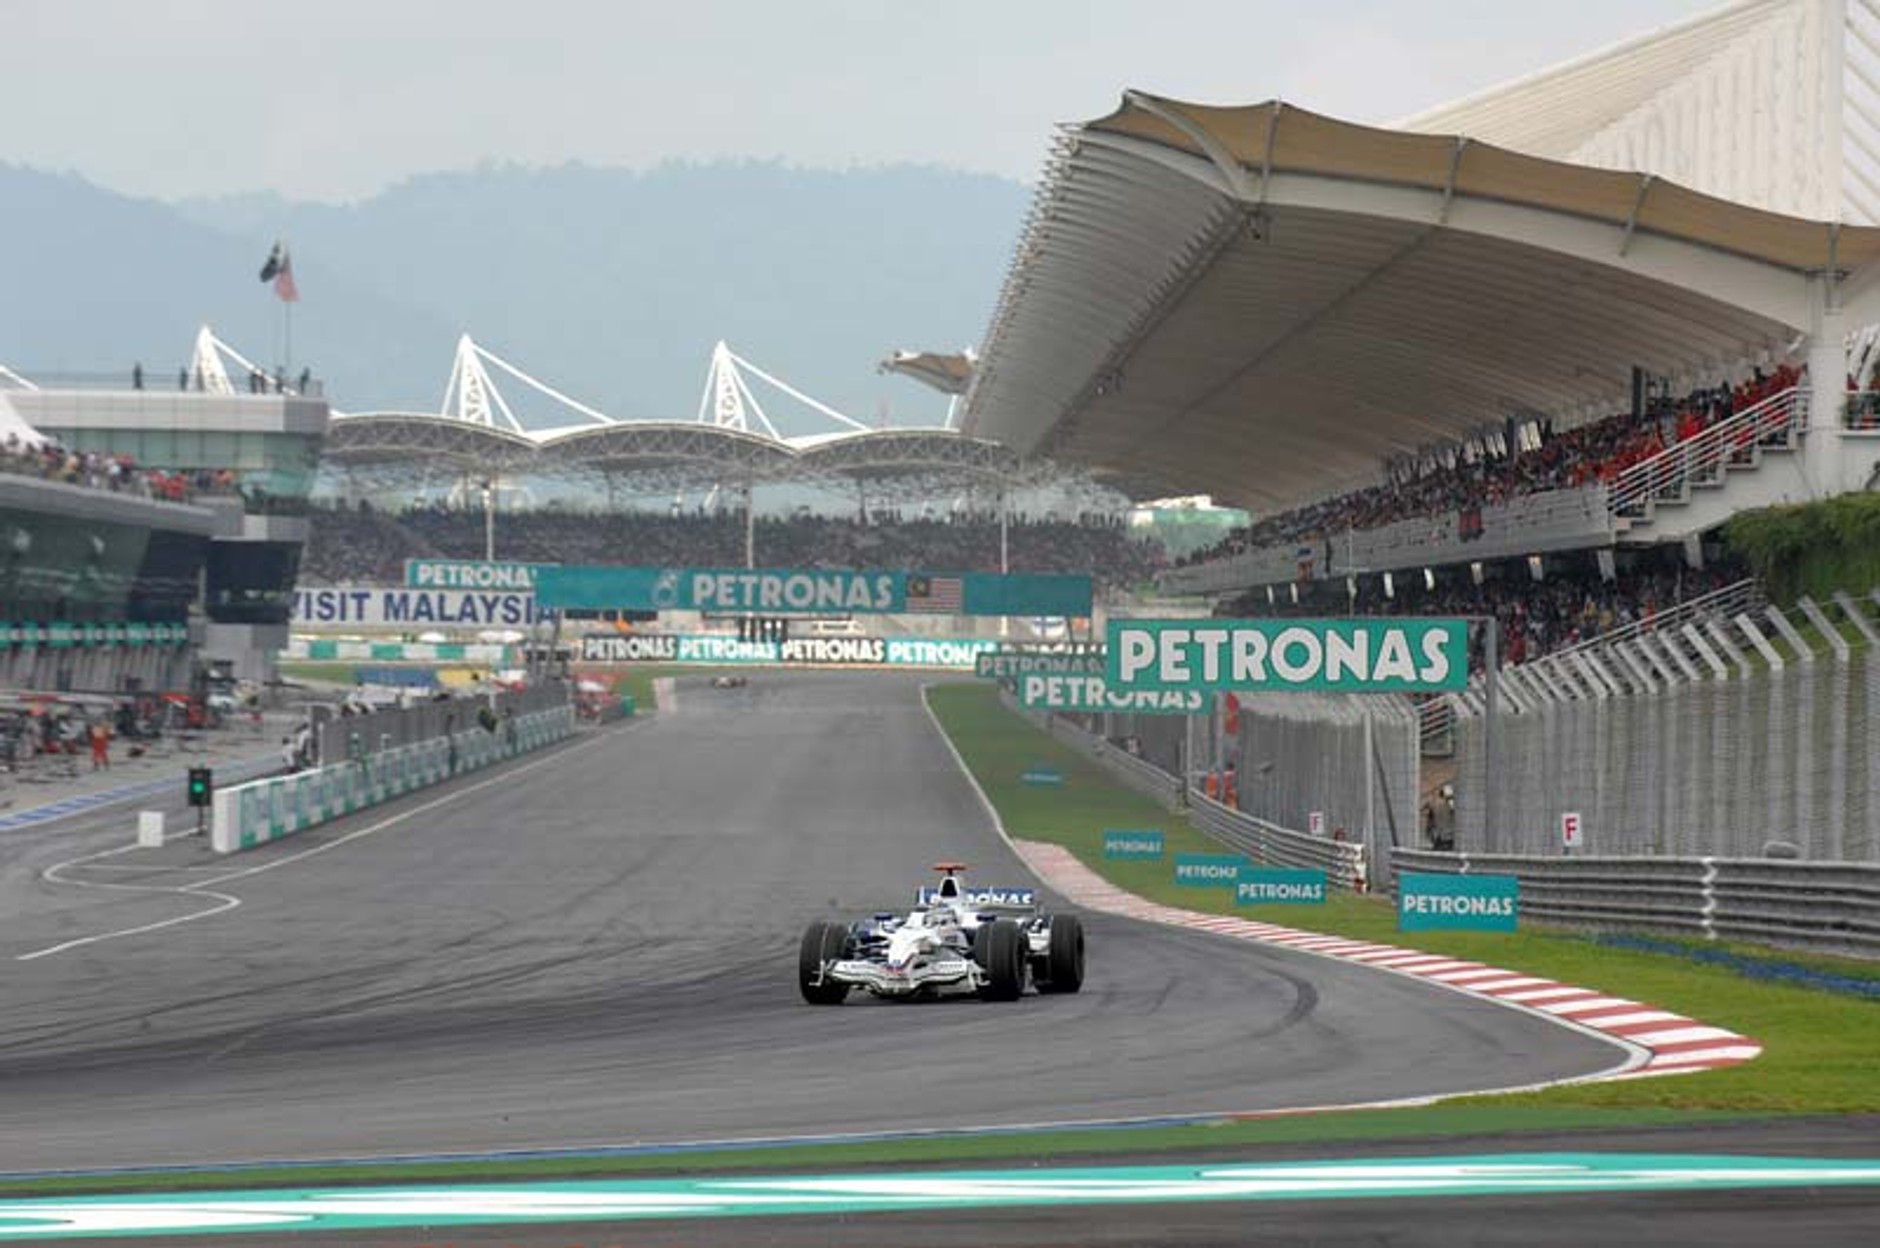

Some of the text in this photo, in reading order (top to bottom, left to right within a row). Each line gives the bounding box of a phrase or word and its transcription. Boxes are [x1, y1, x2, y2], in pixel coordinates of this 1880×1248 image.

[417, 564, 537, 587] PETRONA
[693, 574, 892, 609] PETRONAS
[585, 636, 675, 659] PETRONAS
[782, 639, 884, 661] PETRONAS
[1120, 628, 1450, 682] PETRONAS
[1565, 818, 1576, 841] F
[1238, 883, 1322, 899] PETRONAS
[1404, 895, 1513, 916] PETRONAS
